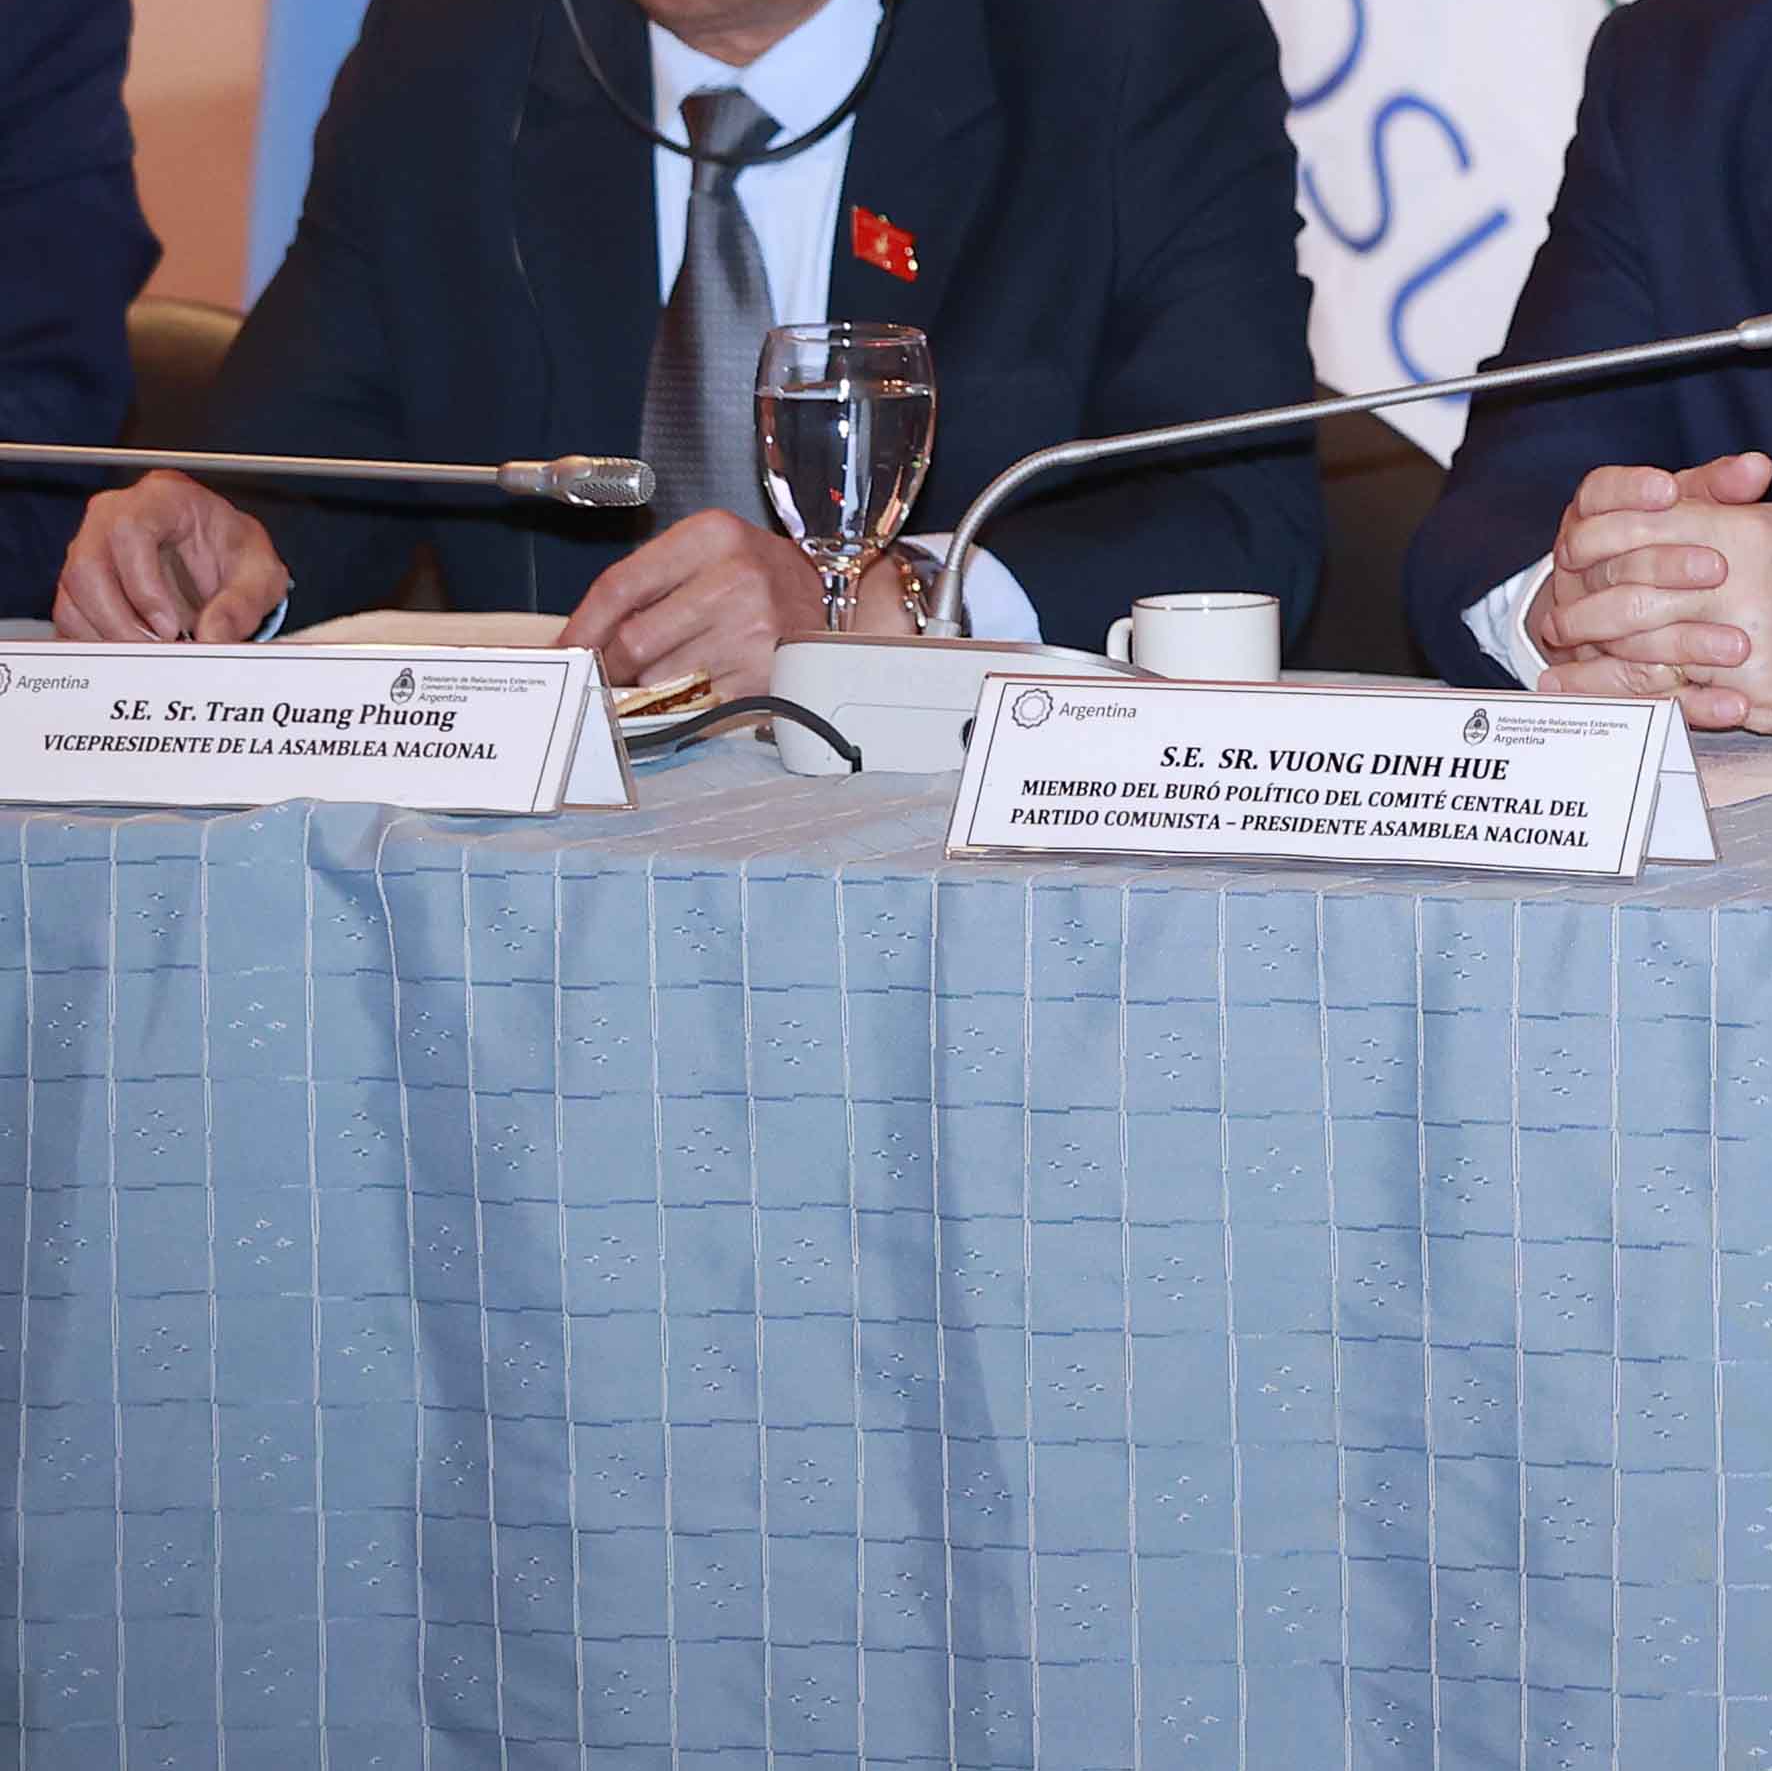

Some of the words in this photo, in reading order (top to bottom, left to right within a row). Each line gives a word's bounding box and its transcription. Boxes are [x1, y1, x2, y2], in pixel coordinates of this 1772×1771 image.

[16, 676, 89, 693] Argentina
[110, 700, 151, 720] S.E.
[165, 701, 196, 721] Sr.
[207, 702, 264, 722] Tran
[273, 703, 353, 730] Quang
[359, 704, 456, 732] Phuong
[1059, 702, 1136, 720] Argentina
[45, 735, 214, 753] VICEPRESIDENTE
[217, 738, 245, 753] DE
[249, 739, 272, 754] LA
[279, 740, 386, 756] ASAMBLEA
[394, 742, 496, 759] NACIONAL
[1160, 747, 1204, 767] S.E.
[1219, 749, 1257, 769] SR.
[1270, 751, 1364, 773] VUONG
[1371, 755, 1443, 777] DINH
[1450, 758, 1509, 780] HUE
[1022, 780, 1116, 797] MIEMBRO
[1122, 783, 1158, 798] DEL
[1165, 781, 1220, 800] BURÓ
[1226, 783, 1319, 804] POLÍTICO
[1325, 790, 1362, 806] DEL
[1368, 790, 1447, 809] COMITÉ
[1451, 795, 1543, 815] CENTRAL
[1550, 800, 1587, 817] DEL
[1011, 809, 1099, 825] PARTIDO
[1104, 811, 1220, 829] COMUNISTA
[1241, 815, 1367, 835] PRESIDENTE
[1370, 821, 1477, 840] ASAMBLEA
[1485, 826, 1588, 847] NACIONAL
